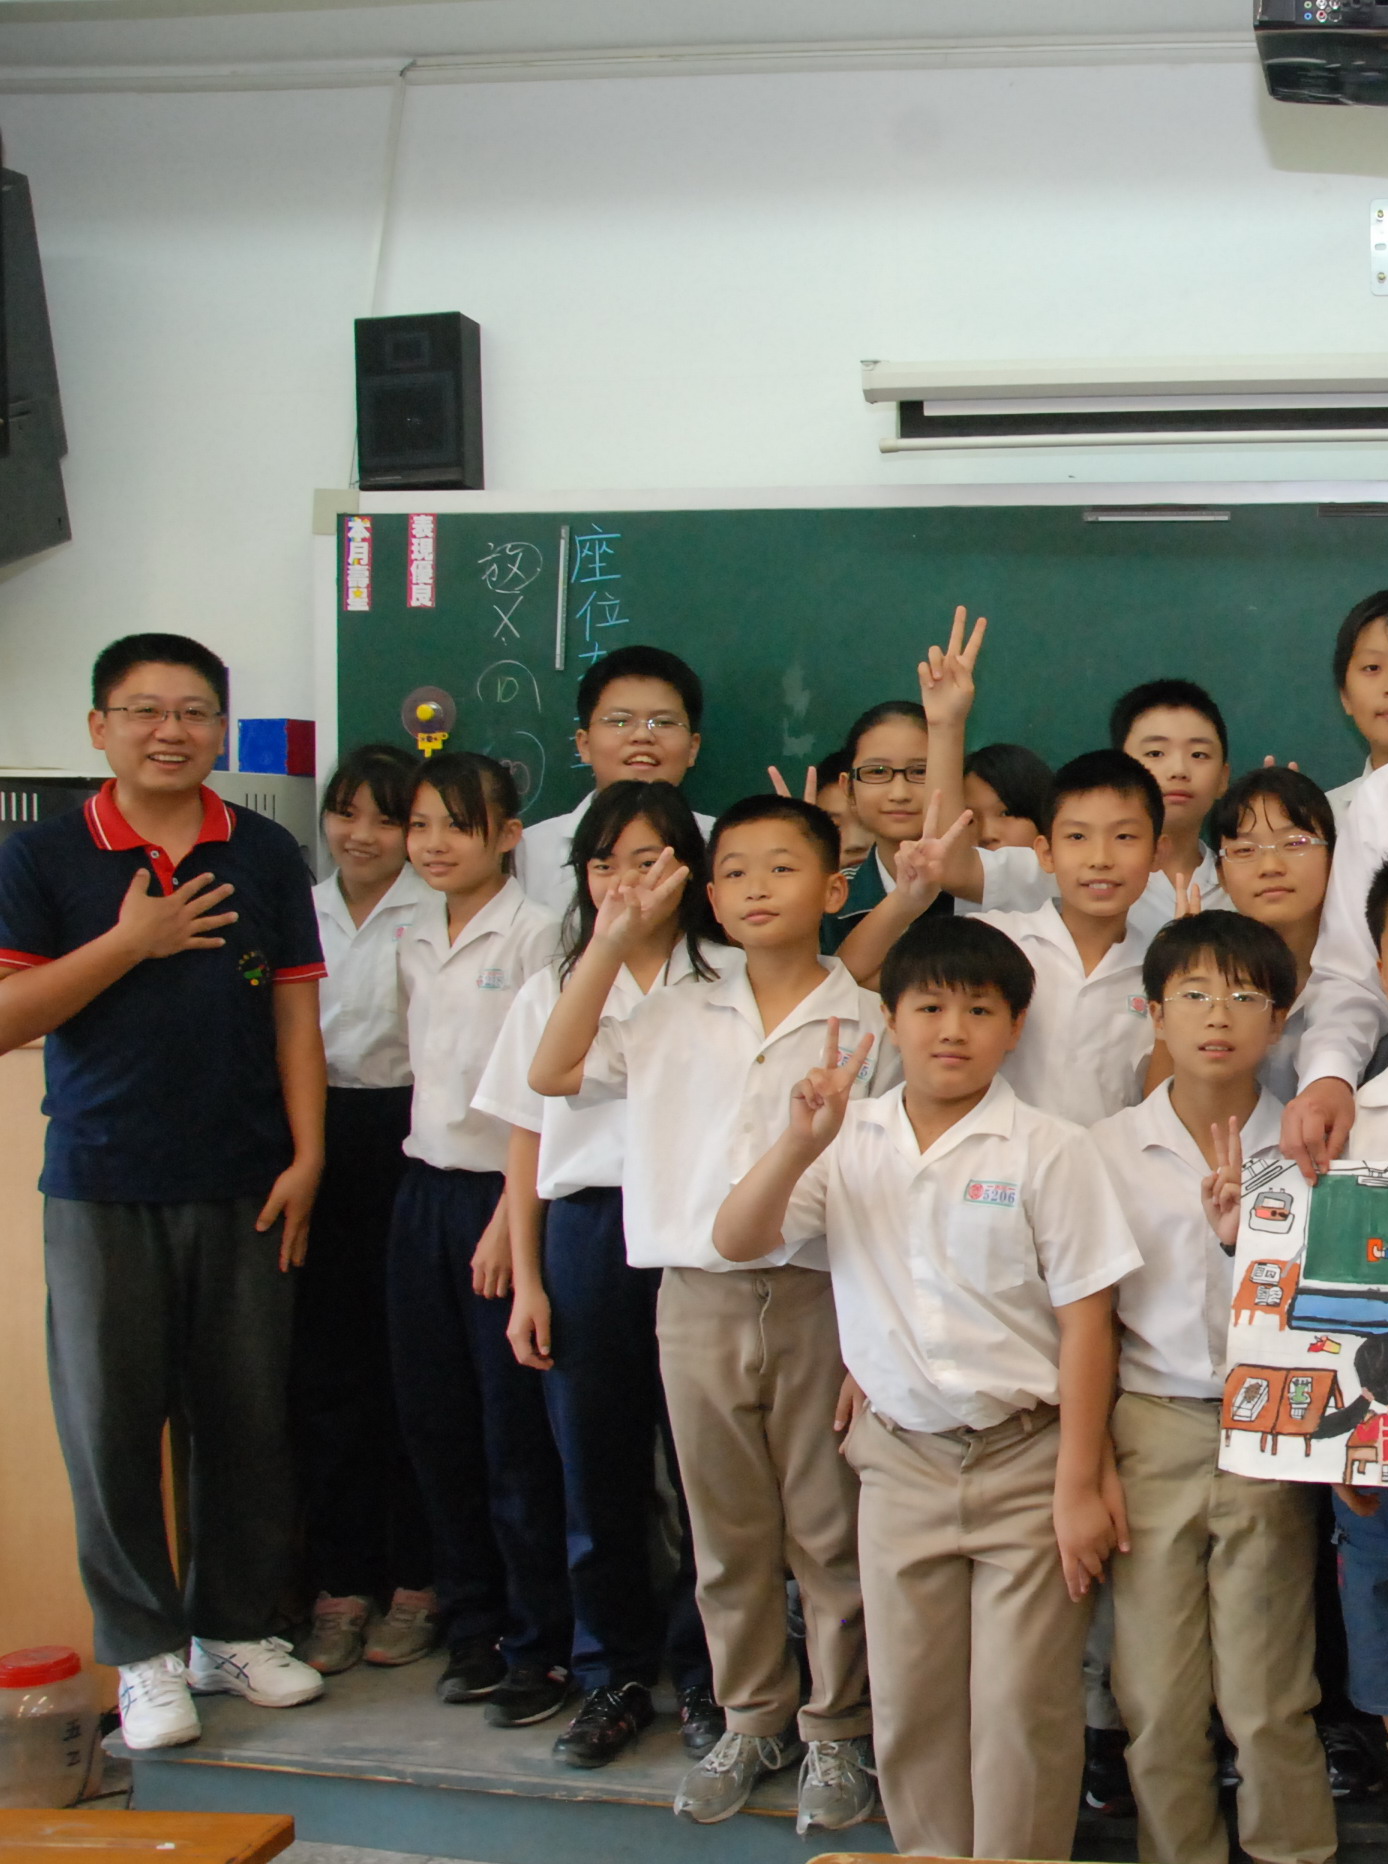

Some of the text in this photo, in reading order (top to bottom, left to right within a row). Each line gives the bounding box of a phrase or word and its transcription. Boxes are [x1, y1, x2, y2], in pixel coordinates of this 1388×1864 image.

[410, 514, 434, 607] 表現優良
[983, 1189, 1016, 1204] 5206
